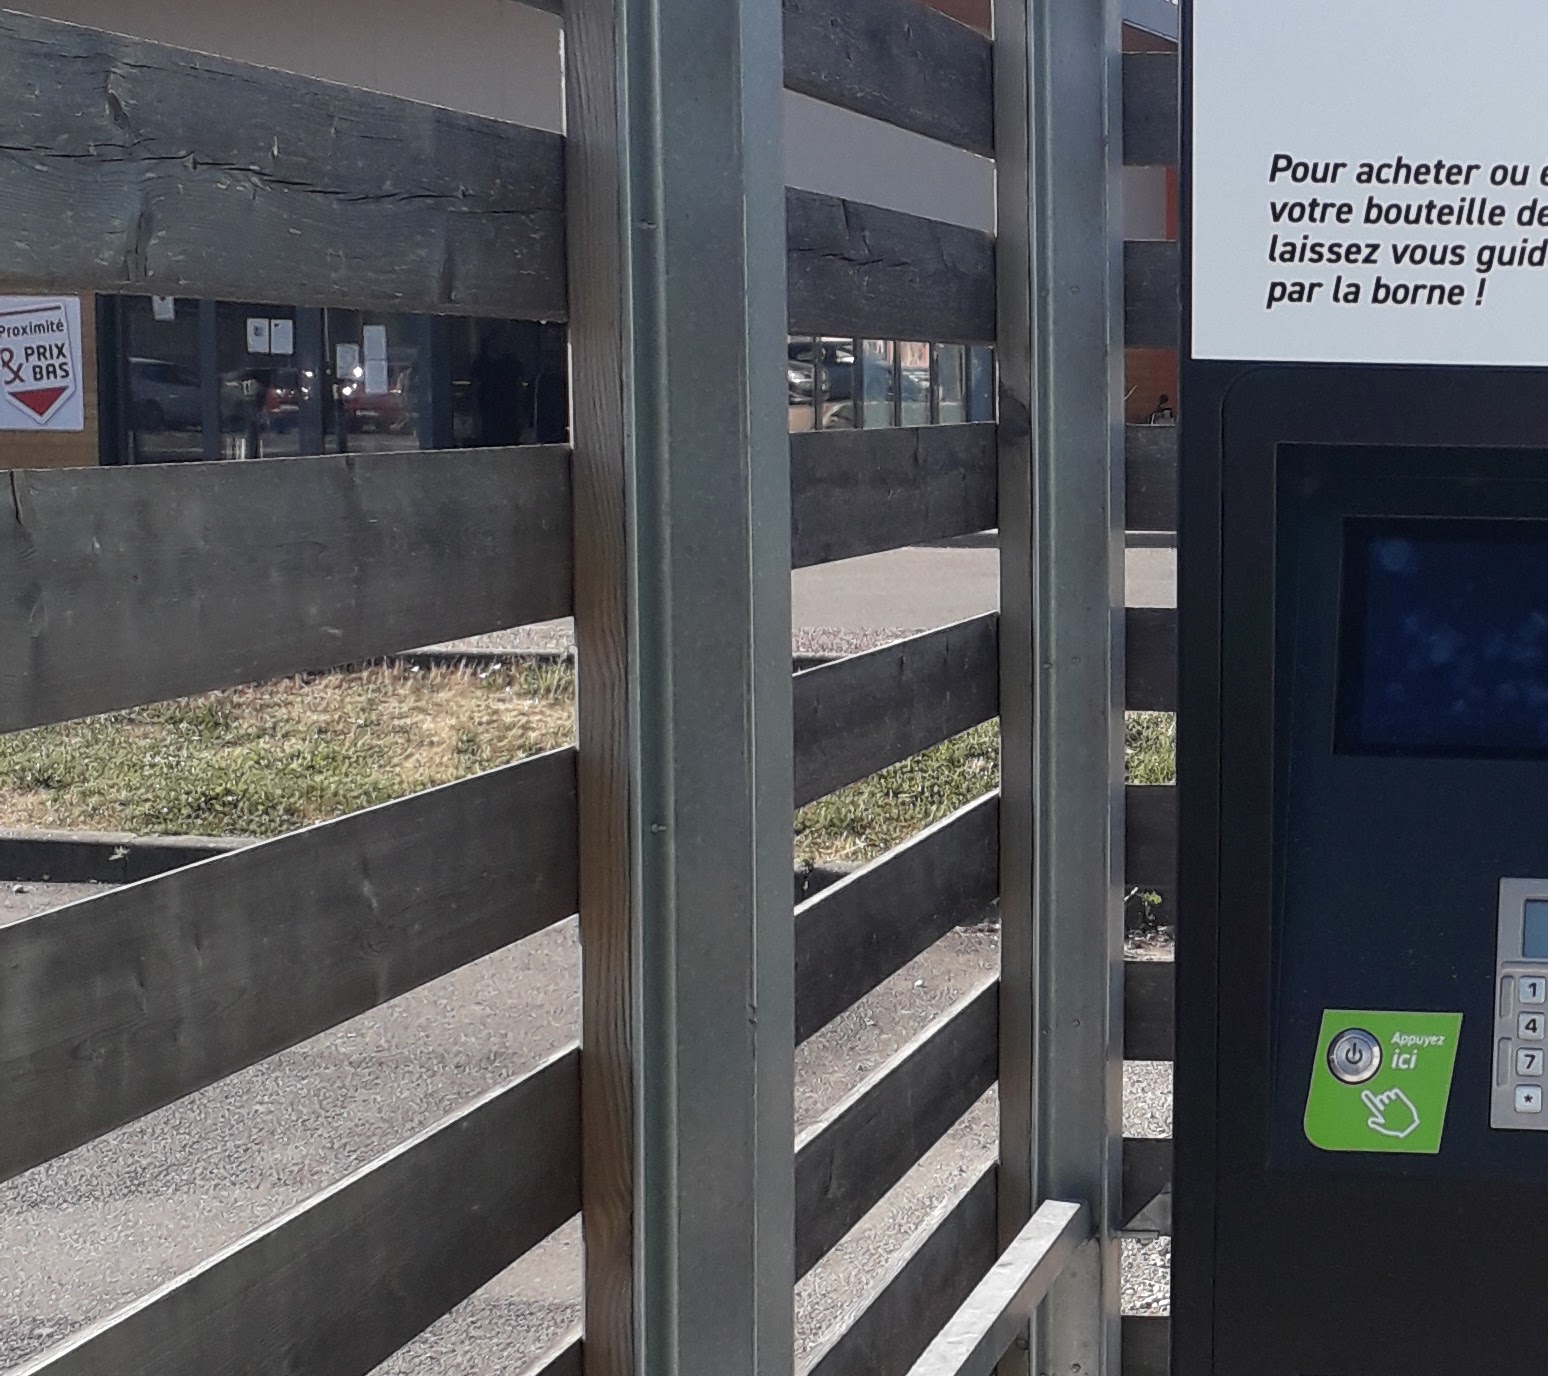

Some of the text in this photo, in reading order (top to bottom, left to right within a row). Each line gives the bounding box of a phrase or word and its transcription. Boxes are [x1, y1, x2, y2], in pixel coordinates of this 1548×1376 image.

[1268, 153, 1348, 184] Pour
[1355, 155, 1482, 186] acheter
[1489, 164, 1530, 186] ou
[1269, 197, 1354, 224] votre
[1363, 195, 1506, 226] bouteille
[1268, 233, 1381, 265] laissez
[1391, 243, 1466, 266] vous
[1265, 281, 1324, 310] par
[1332, 275, 1361, 304] la
[1371, 275, 1465, 306] borne
[24, 343, 67, 363] PRIX
[32, 362, 70, 381] BAS
[1527, 982, 1537, 998] 1
[1524, 1017, 1538, 1034] 4
[1390, 1031, 1446, 1048] Appuyez
[1391, 1048, 1418, 1070] ici
[1523, 1053, 1536, 1070] 7
